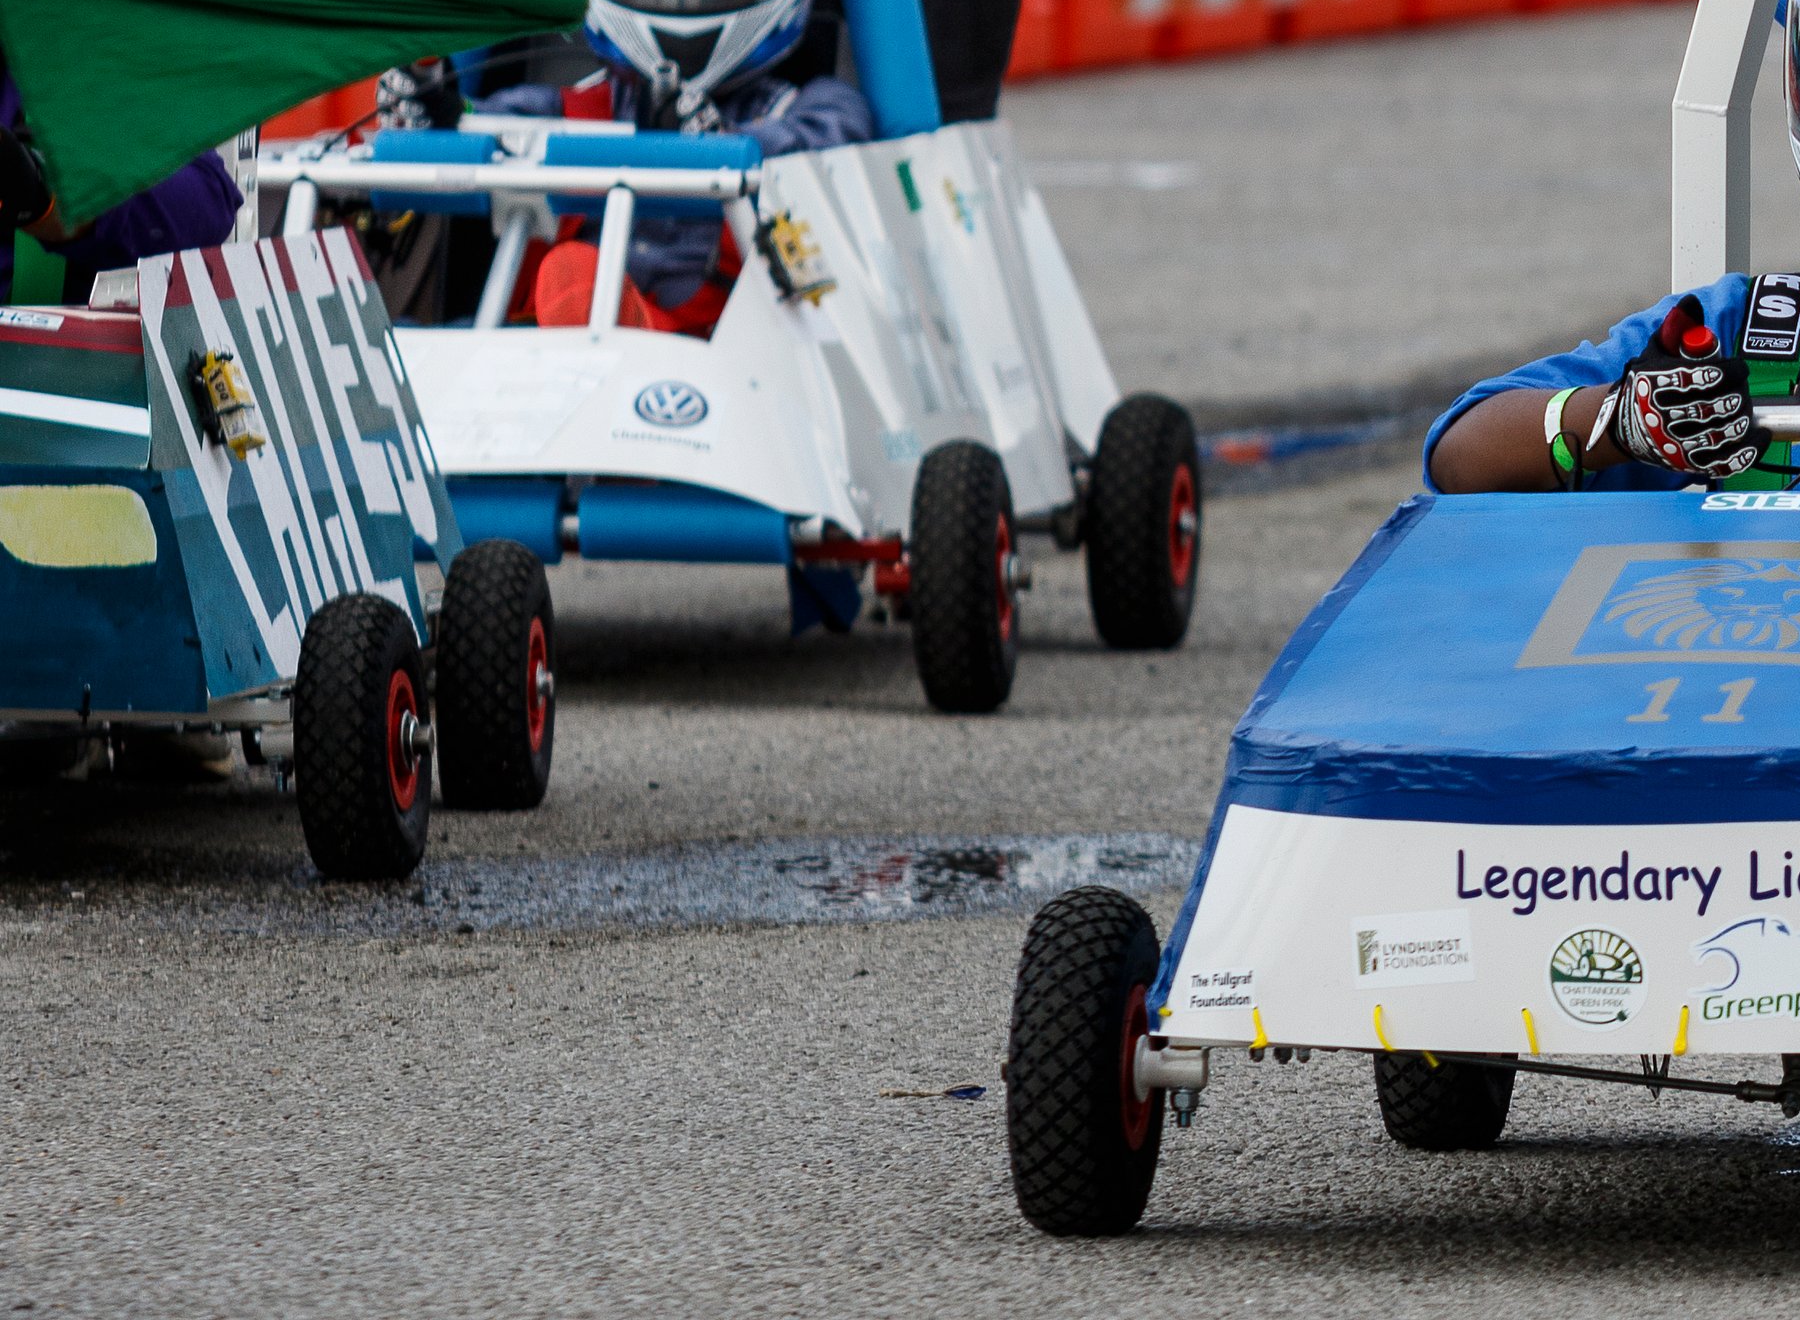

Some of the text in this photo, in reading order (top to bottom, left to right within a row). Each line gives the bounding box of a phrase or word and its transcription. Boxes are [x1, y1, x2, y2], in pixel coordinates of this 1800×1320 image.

[1456, 848, 1722, 917] Legendary
[1382, 938, 1462, 956] LYNDHURST
[1383, 951, 1470, 970] FOUNDATION
[1190, 969, 1254, 990] The Fullgraf
[1189, 993, 1251, 1009] Foundation
